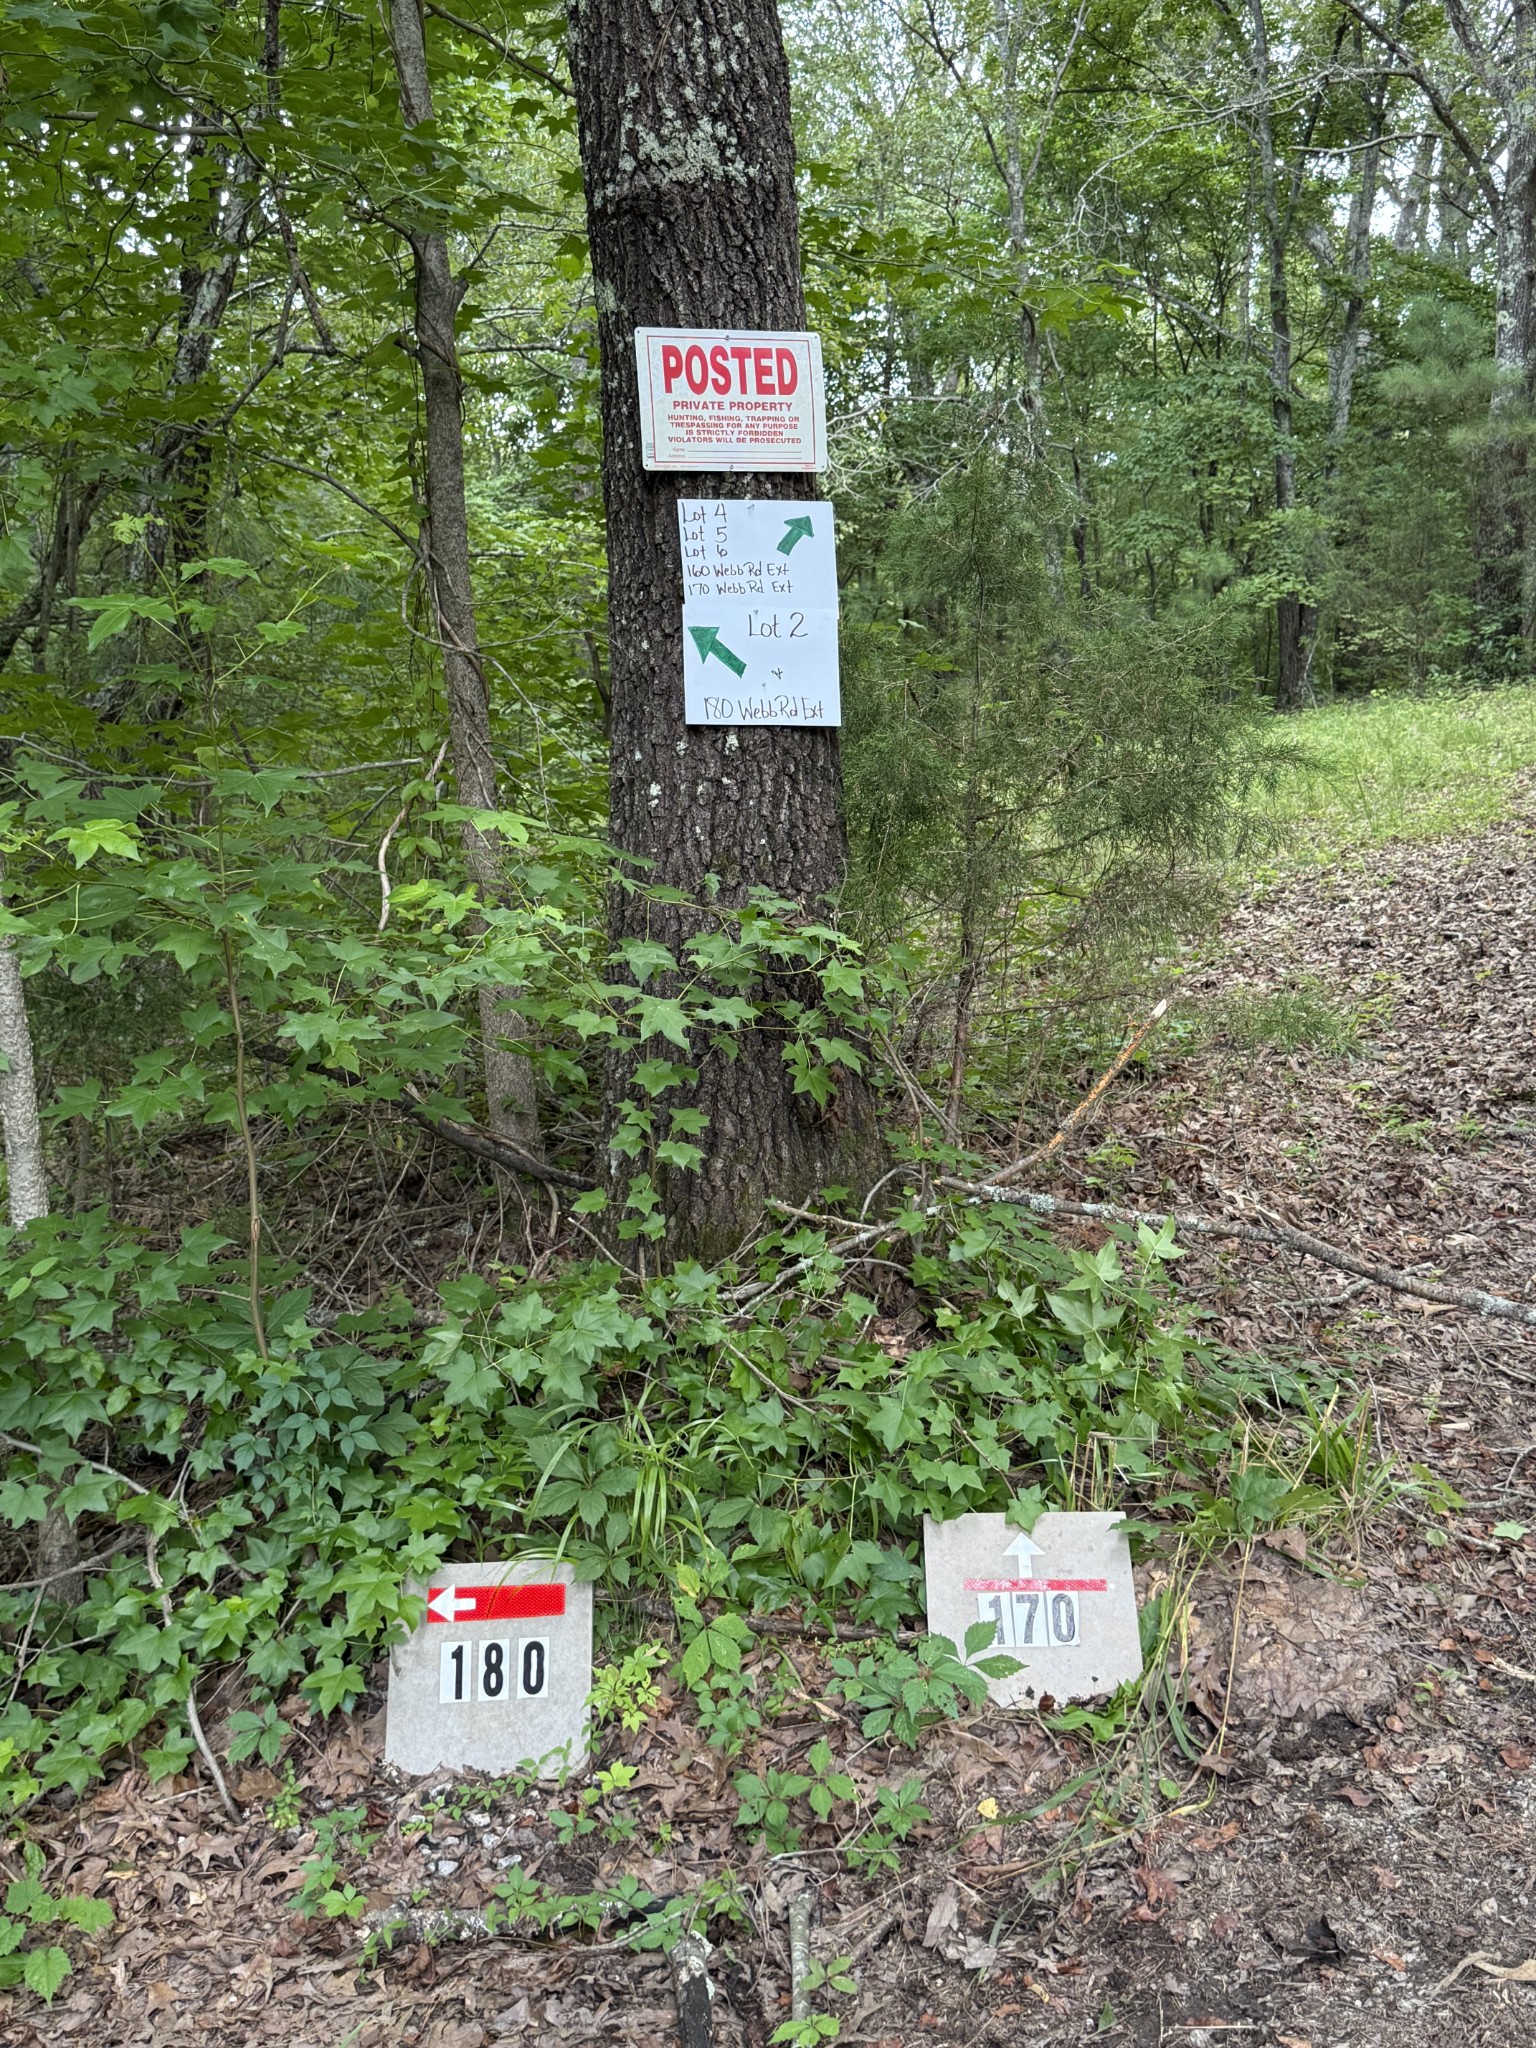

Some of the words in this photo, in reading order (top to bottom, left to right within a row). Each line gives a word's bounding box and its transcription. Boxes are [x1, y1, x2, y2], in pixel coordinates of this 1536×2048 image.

[662, 344, 798, 396] POSTED
[672, 400, 725, 411] PRIVATE
[729, 401, 793, 412] PROPERTY
[667, 414, 706, 422] HUNTING,
[708, 415, 743, 423] FISHING,
[745, 415, 785, 423] TRAPPING
[670, 421, 725, 429] TRESPASSING
[763, 422, 799, 430] PURPOSE
[667, 436, 714, 444] VIOLATORS
[715, 436, 734, 444] WILL
[682, 502, 708, 524] Lot
[714, 503, 728, 523] 4
[683, 525, 706, 543] Lot
[716, 526, 728, 543] 5
[684, 545, 707, 560] Lot
[716, 544, 728, 557] 6
[687, 565, 711, 578] 160
[767, 562, 790, 577] Ext
[688, 583, 710, 596] 170
[716, 581, 746, 595] Webb
[749, 579, 765, 594] Rd
[773, 580, 795, 594] Ext
[748, 613, 782, 638] Lot
[789, 612, 809, 638] 2
[703, 696, 734, 720] 180
[803, 697, 824, 720] Ext
[988, 1593, 1076, 1645] 170
[451, 1640, 545, 1700] 180
